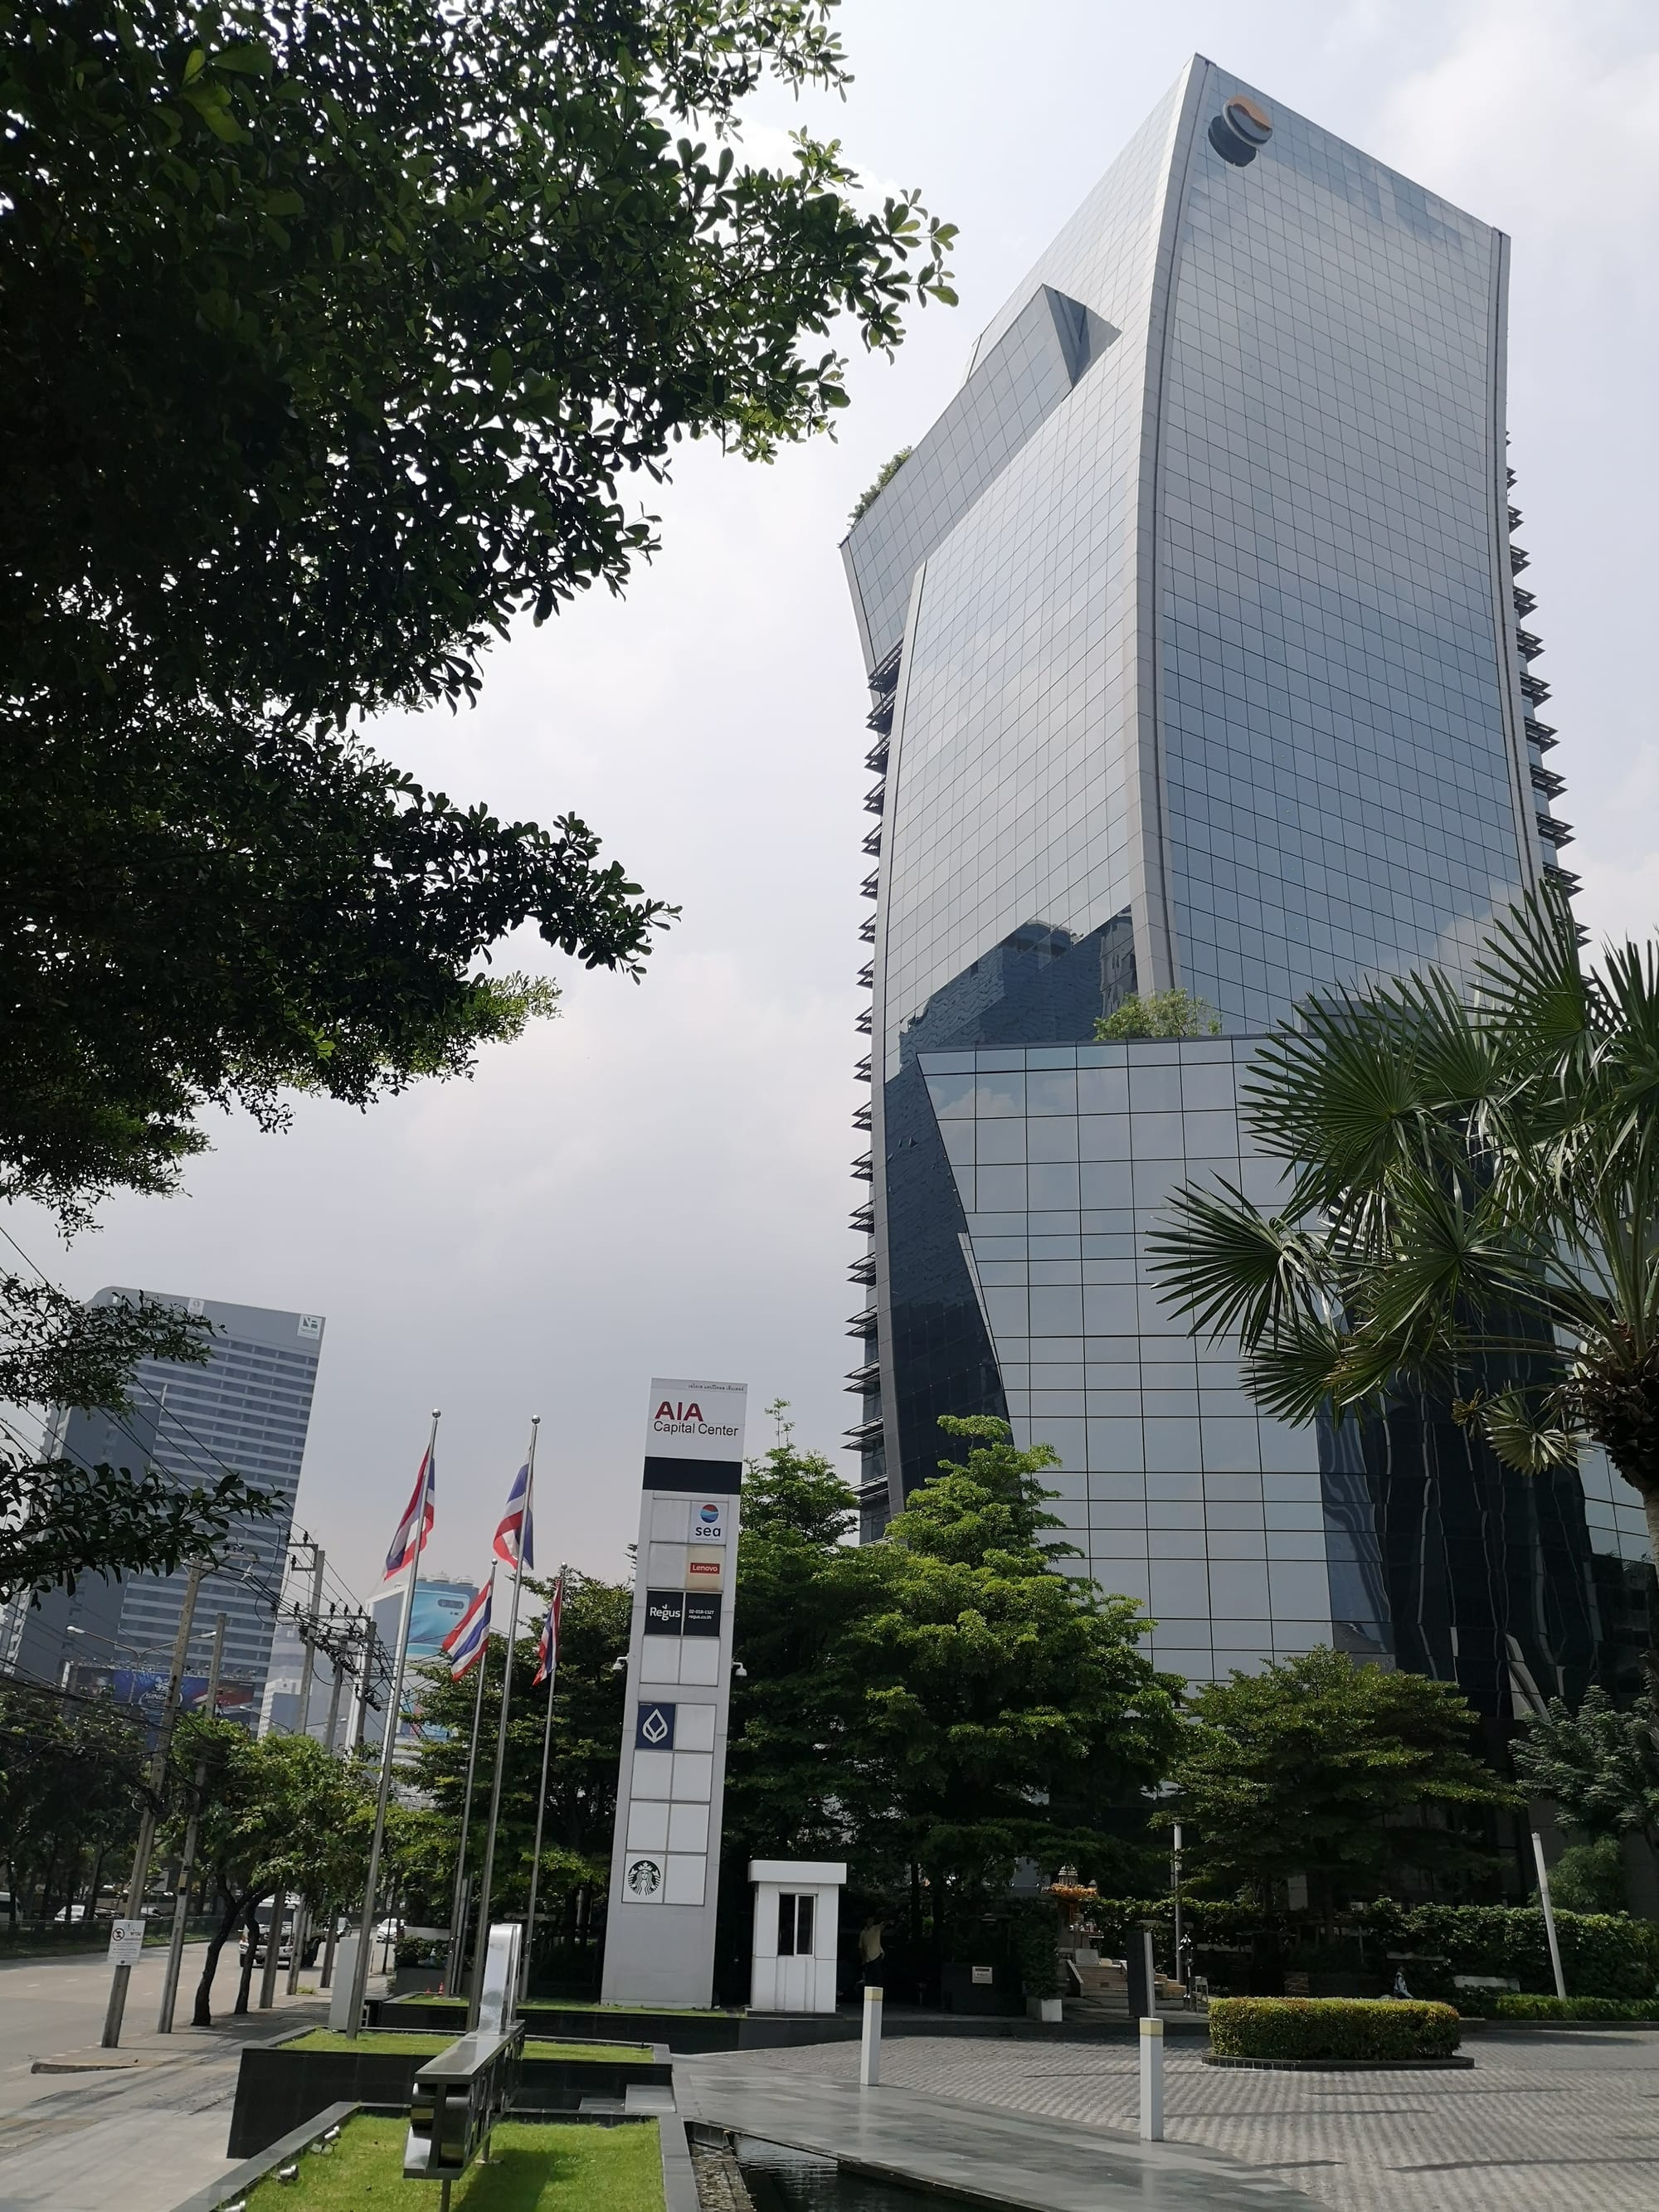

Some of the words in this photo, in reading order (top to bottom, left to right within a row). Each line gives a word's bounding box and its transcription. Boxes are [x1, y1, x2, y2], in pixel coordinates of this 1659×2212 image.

[654, 1401, 703, 1422] AIA
[654, 1420, 696, 1436] Capital
[698, 1422, 739, 1437] Center
[695, 1526, 722, 1537] sea
[692, 1563, 718, 1572] Lenovo
[649, 1607, 681, 1621] Regus
